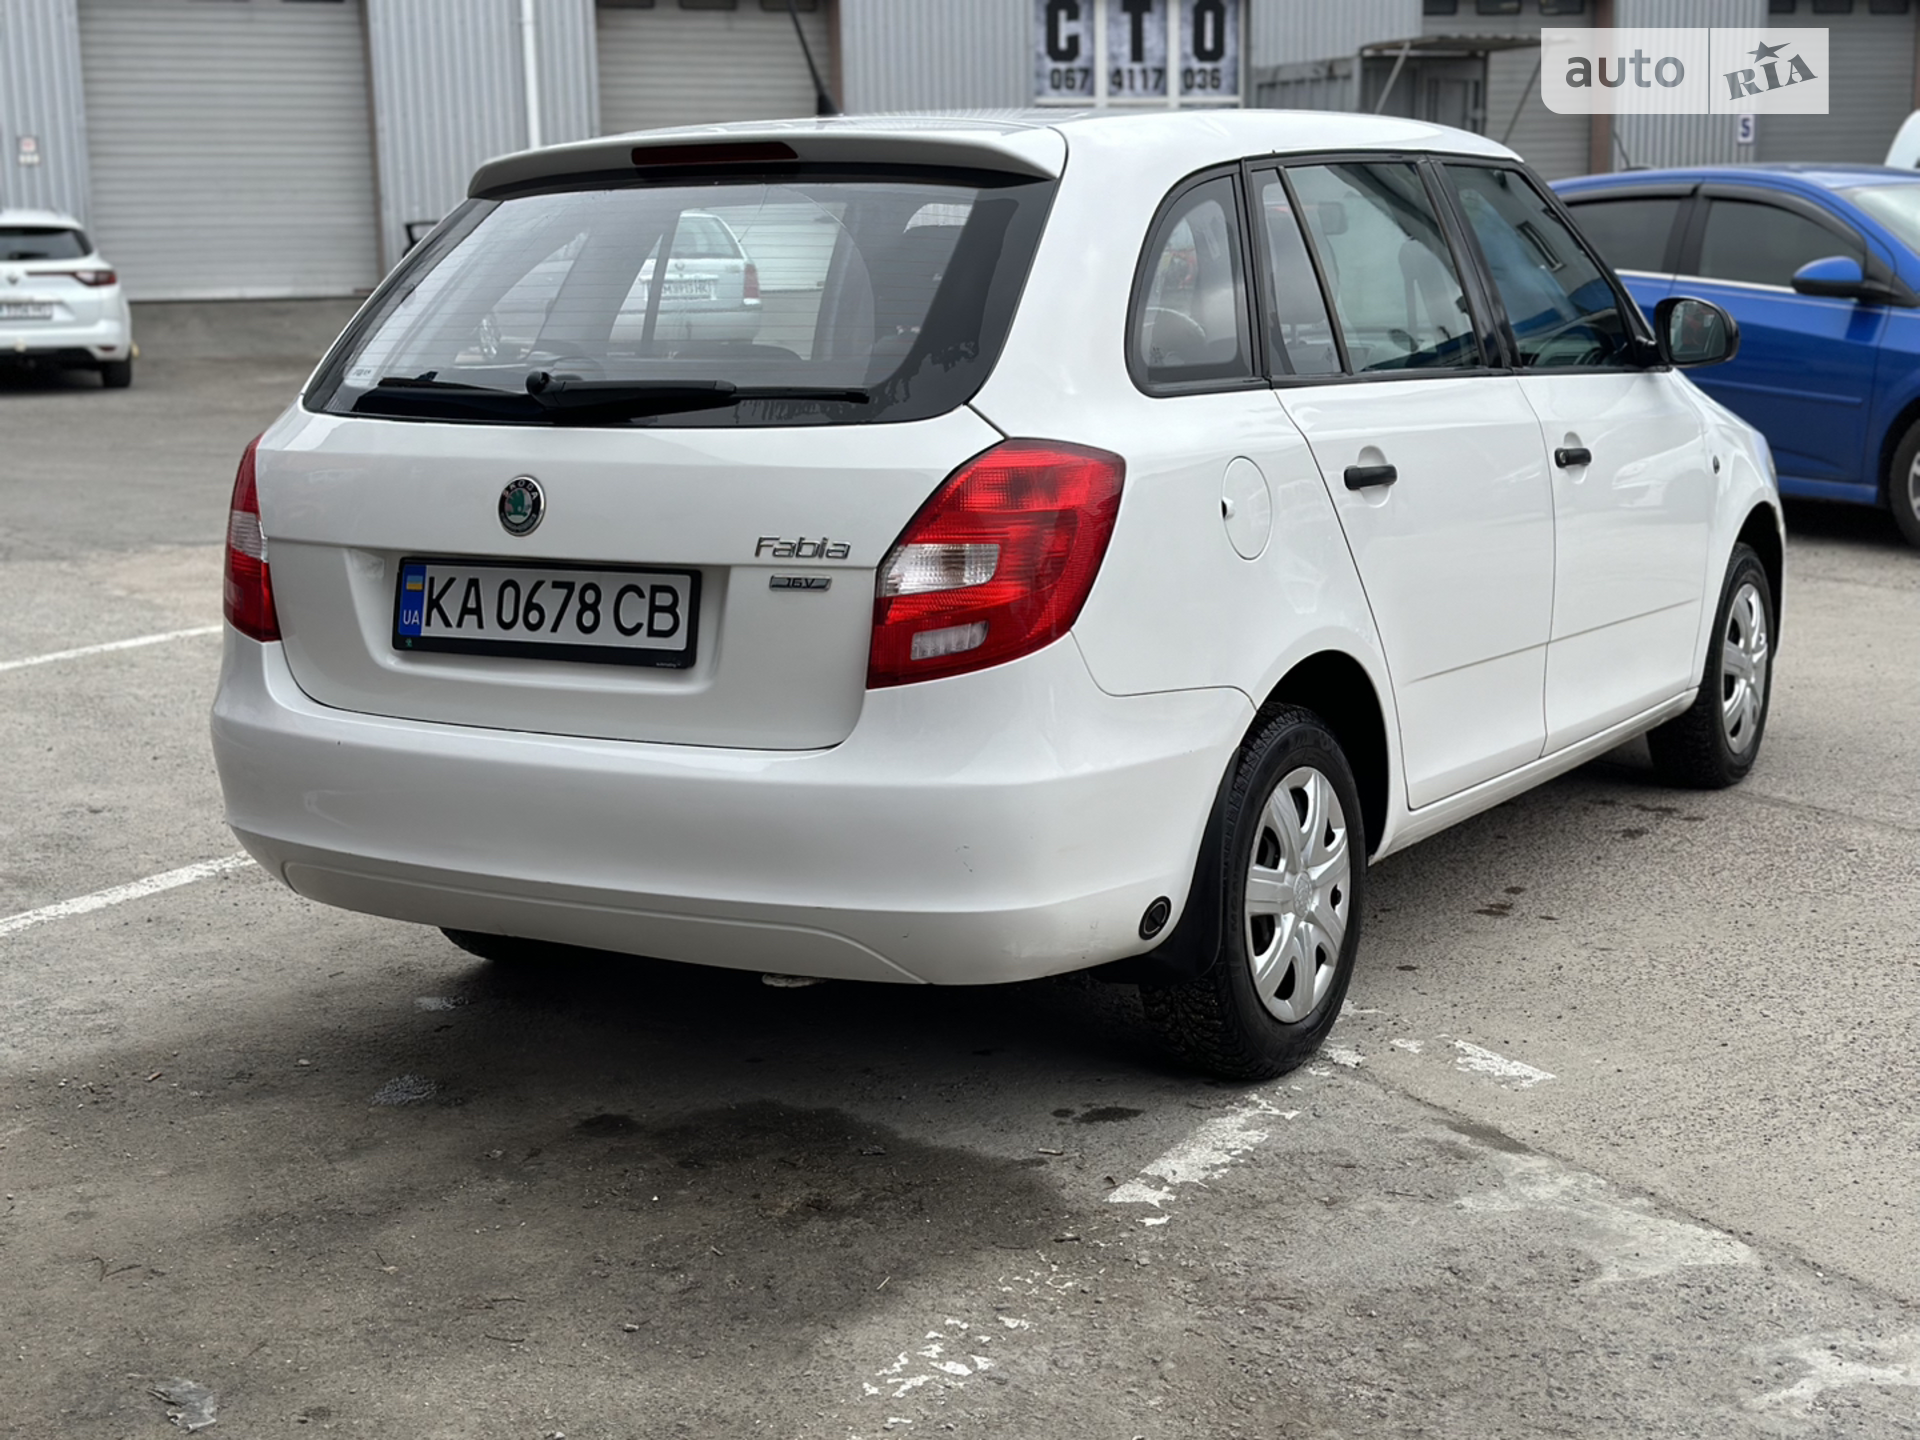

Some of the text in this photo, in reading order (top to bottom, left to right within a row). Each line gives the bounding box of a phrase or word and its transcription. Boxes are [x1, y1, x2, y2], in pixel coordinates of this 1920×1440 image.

[1050, 67, 1222, 91] 067 4117 036
[754, 536, 852, 559] Fabia
[403, 609, 420, 626] UA
[425, 576, 681, 638] KA 0678 CB
